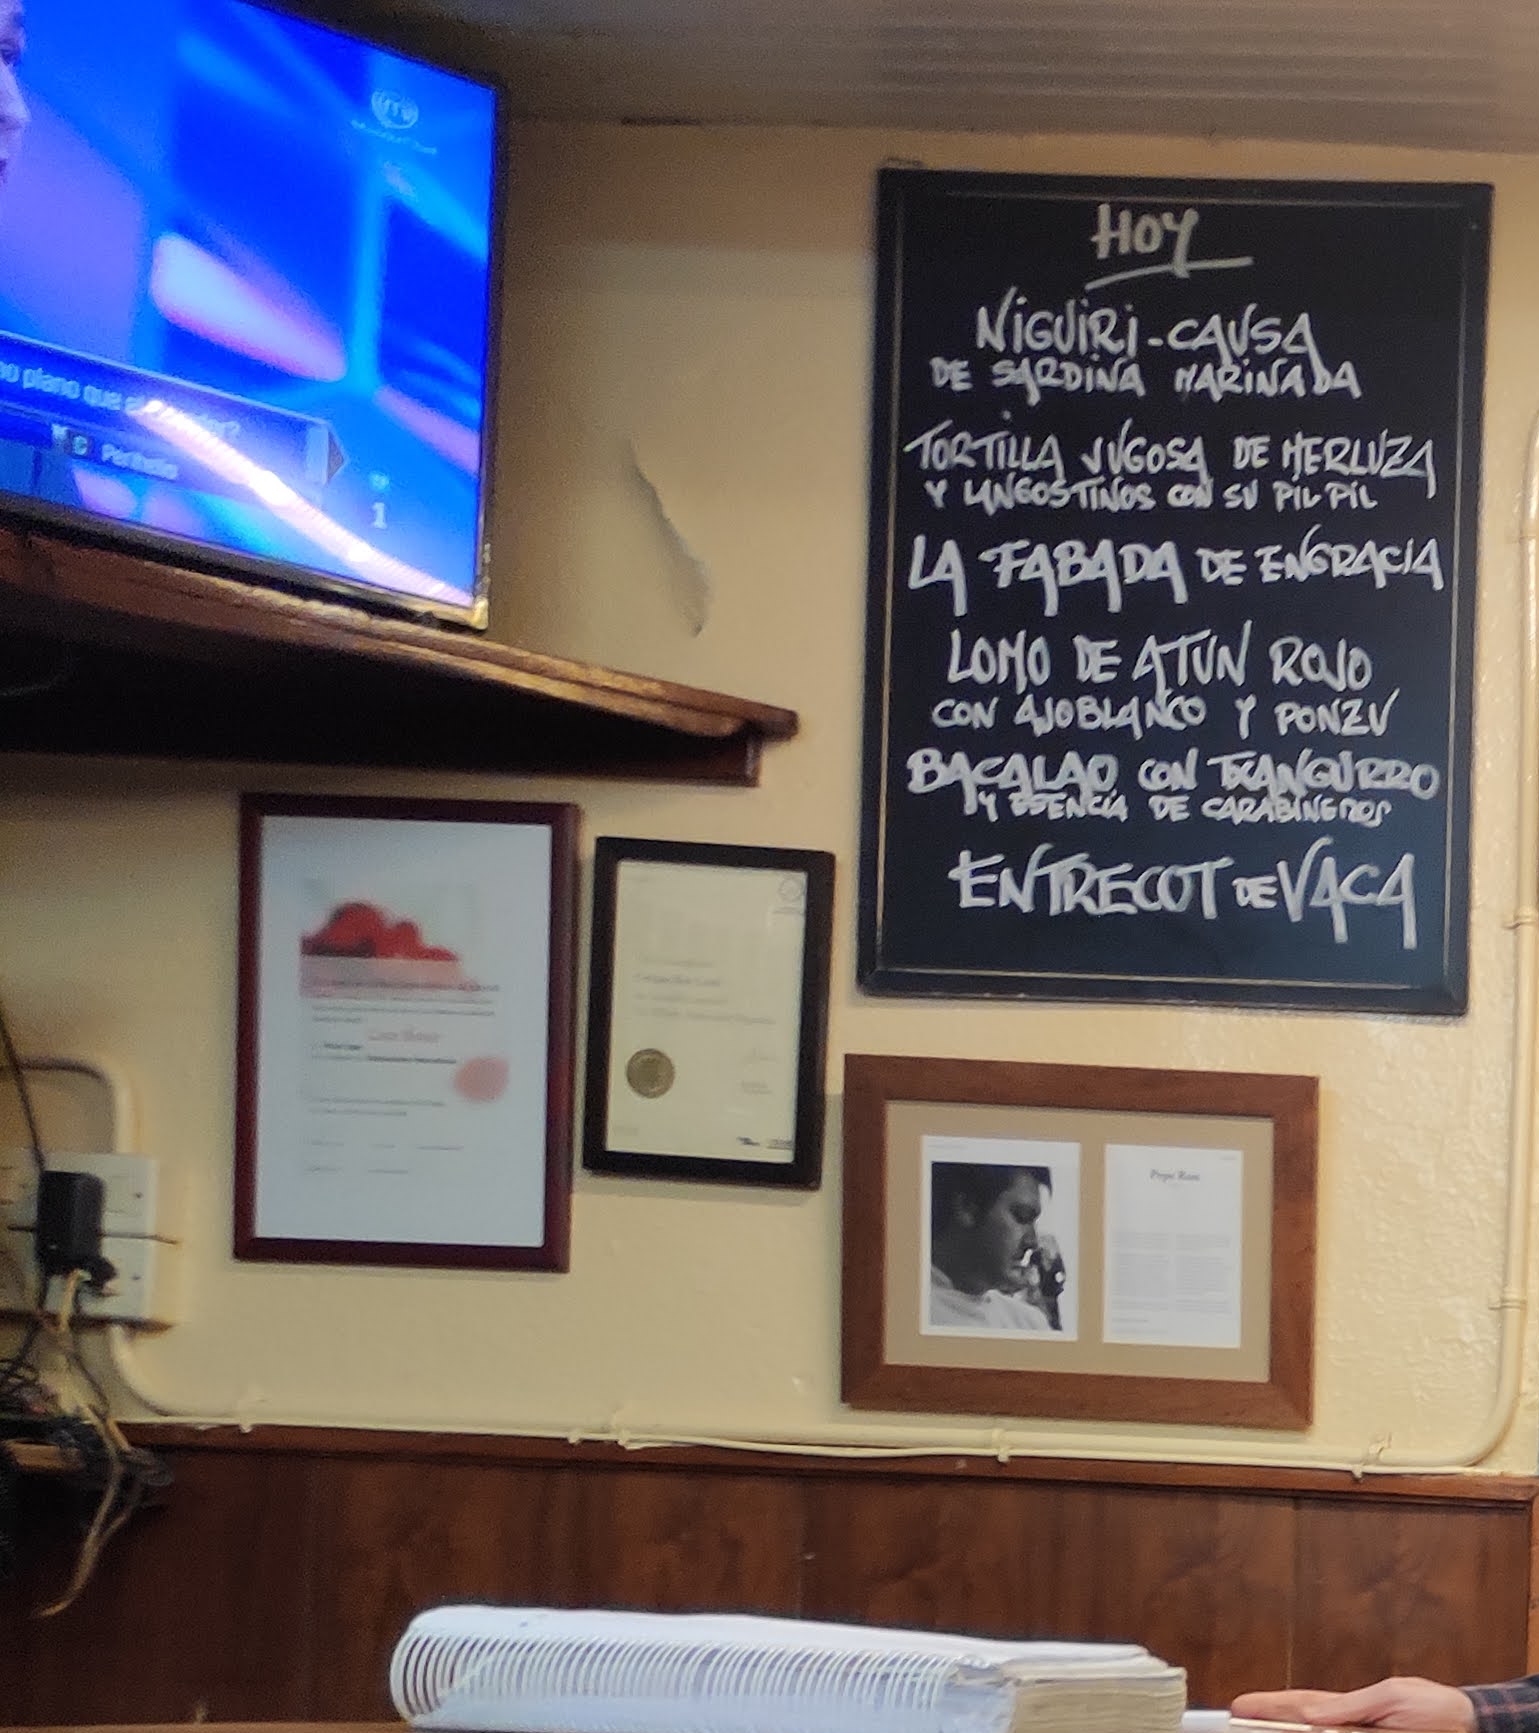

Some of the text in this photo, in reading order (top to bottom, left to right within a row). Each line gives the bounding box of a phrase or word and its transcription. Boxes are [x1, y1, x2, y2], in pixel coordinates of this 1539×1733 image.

[1091, 203, 1199, 279] HOY
[931, 356, 972, 391] DE
[1167, 478, 1214, 510] CON
[1225, 484, 1258, 510] SU
[1234, 434, 1271, 469] DE
[1282, 429, 1436, 499] MERLUZA
[909, 525, 1444, 617] LA FABADA DE ENGRACIA
[947, 629, 1051, 694] LOMO
[1074, 635, 1122, 684] DE
[1270, 636, 1374, 691] ROJO
[932, 688, 1400, 740] CON AJOBLANCO Y PONZU
[907, 748, 1119, 815] BACALAO
[1138, 749, 1199, 791] CON
[1148, 794, 1191, 822] DE
[948, 842, 1234, 920] ENTRECOT
[1276, 836, 1418, 950] VACA
